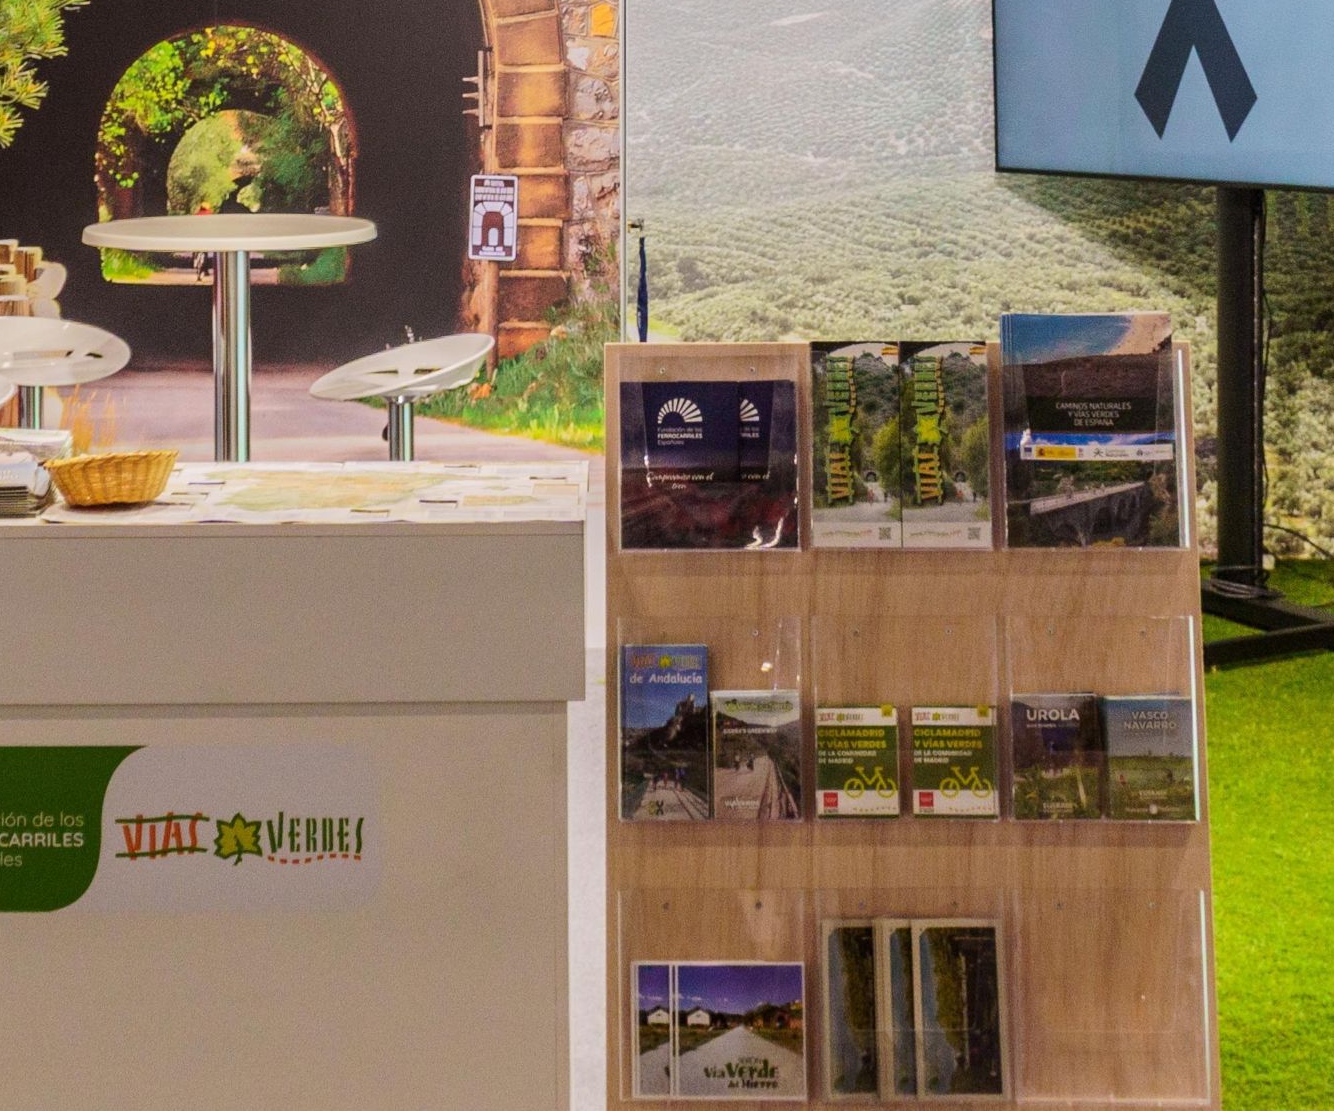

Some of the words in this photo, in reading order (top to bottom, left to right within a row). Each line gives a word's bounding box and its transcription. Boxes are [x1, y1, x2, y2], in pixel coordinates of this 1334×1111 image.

[1056, 402, 1088, 410] CAMINOS
[1089, 401, 1132, 410] NATURALES
[1092, 410, 1120, 418] VERDES
[629, 673, 643, 684] de
[649, 672, 703, 684] Andalucía
[1026, 708, 1080, 721] UROLA
[1131, 711, 1169, 720] VASCO
[1123, 720, 1178, 730] NAVARRO
[818, 729, 885, 737] CICLAMADRID
[914, 729, 981, 737] CICLAMADRID
[851, 740, 887, 749] VERDES
[914, 740, 920, 749] Y
[947, 740, 983, 749] VERDES
[32, 811, 54, 827] de
[60, 811, 85, 827] los
[116, 812, 210, 861] VIAS
[267, 811, 364, 854] VERDES
